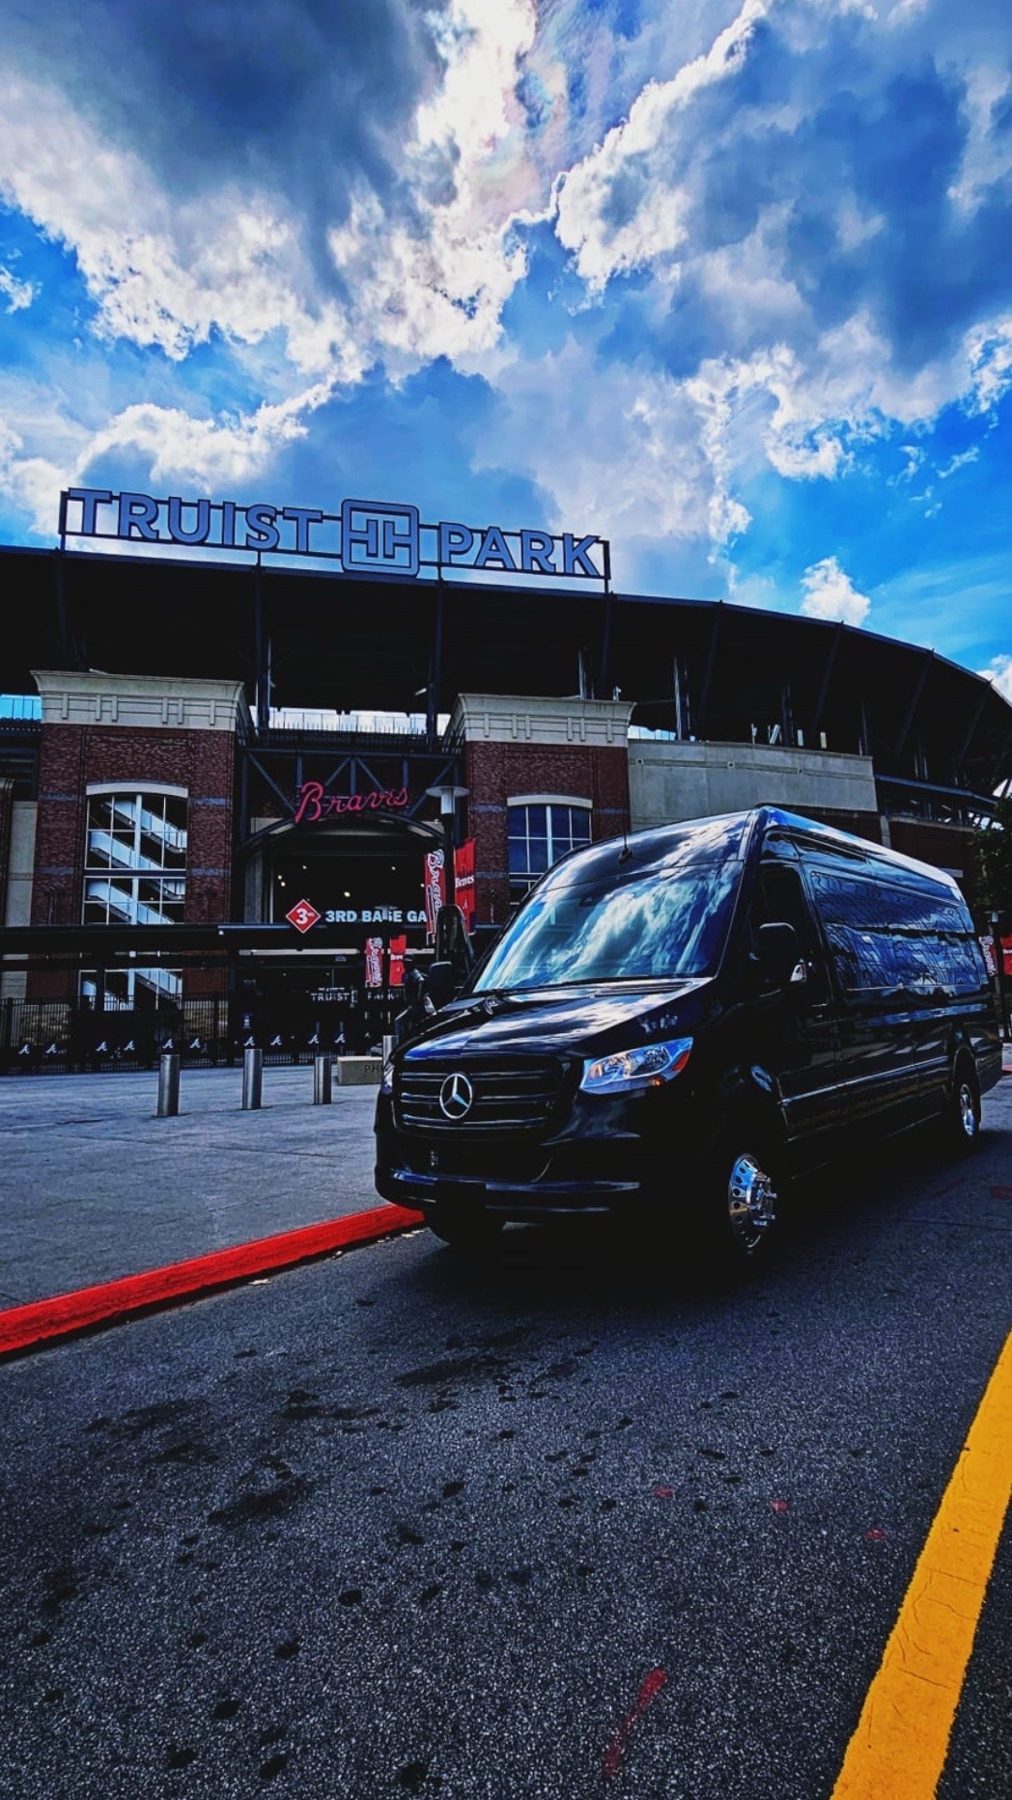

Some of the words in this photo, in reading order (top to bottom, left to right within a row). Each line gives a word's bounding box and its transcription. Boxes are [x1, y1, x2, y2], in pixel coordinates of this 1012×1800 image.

[68, 487, 324, 552] TRUIST
[438, 521, 601, 577] PARK
[295, 781, 408, 824] Braves
[325, 910, 357, 923] 3RD
[407, 910, 428, 923] GA
